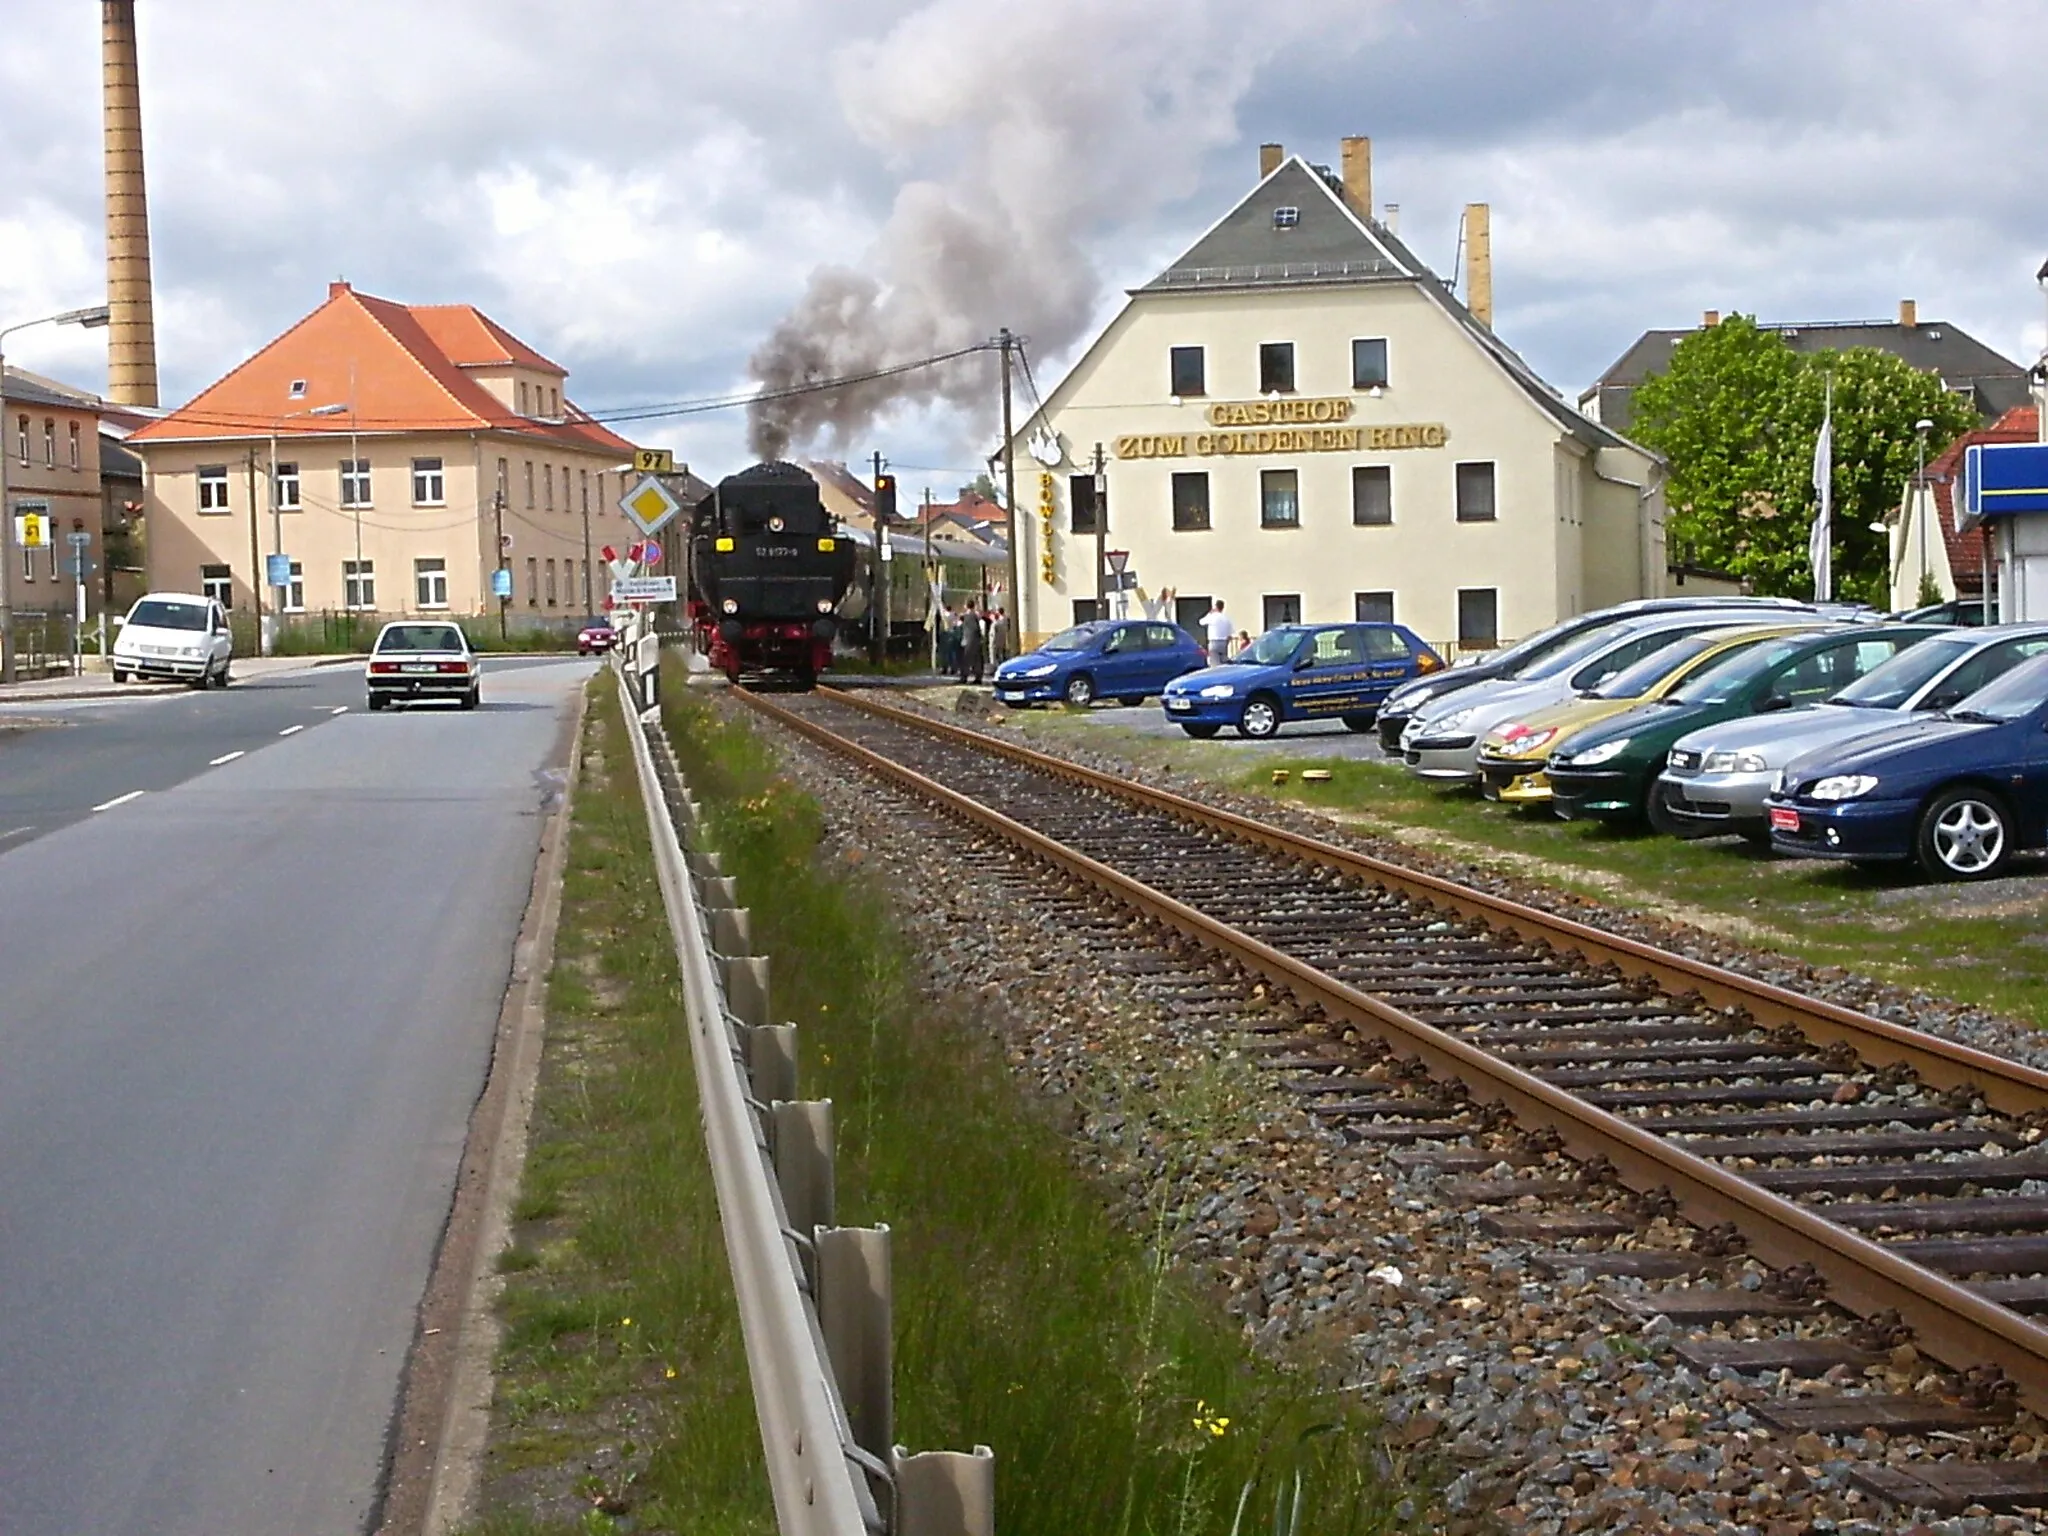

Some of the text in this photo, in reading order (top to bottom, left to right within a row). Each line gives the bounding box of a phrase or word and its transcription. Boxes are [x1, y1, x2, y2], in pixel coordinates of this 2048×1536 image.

[1211, 400, 1350, 427] GASTHOF
[1117, 423, 1445, 459] ZUM GOLDENEN RING
[642, 452, 663, 468] 97
[1040, 472, 1055, 585] BOWLING
